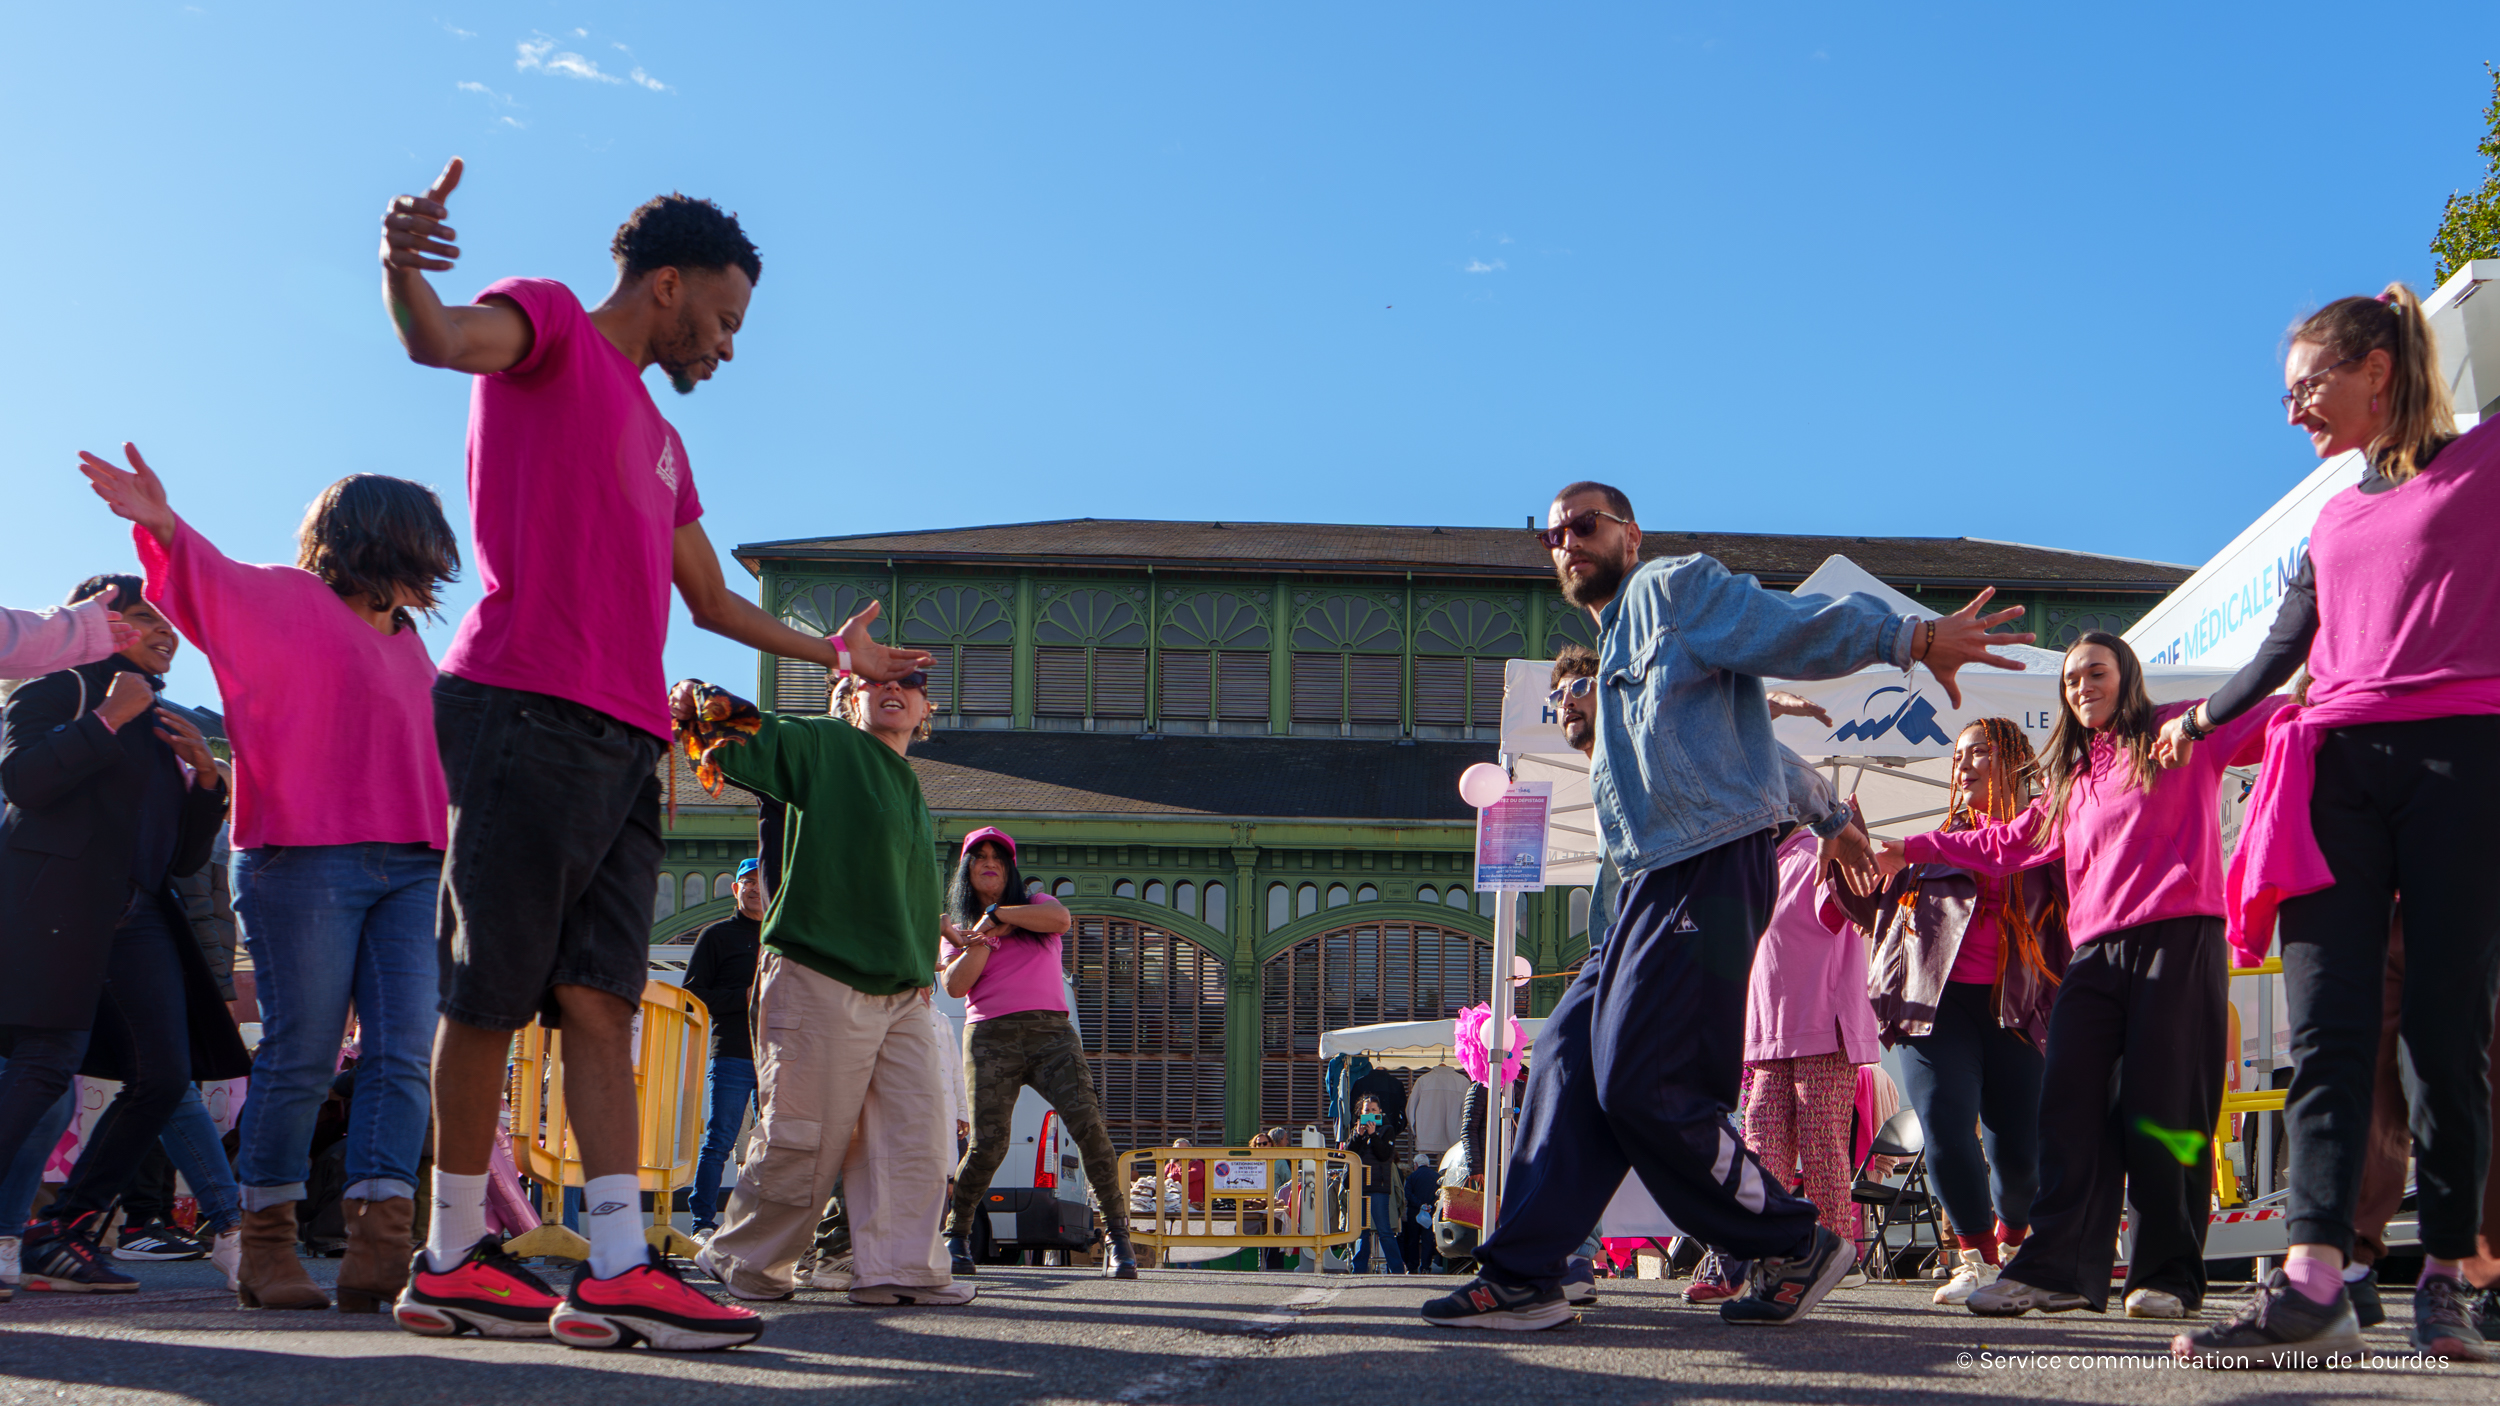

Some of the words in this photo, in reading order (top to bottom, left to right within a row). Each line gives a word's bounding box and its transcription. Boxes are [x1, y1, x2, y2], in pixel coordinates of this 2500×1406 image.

[2185, 564, 2273, 665] MÉDICALE
[2026, 711, 2049, 728] LE
[1469, 1286, 1498, 1312] N
